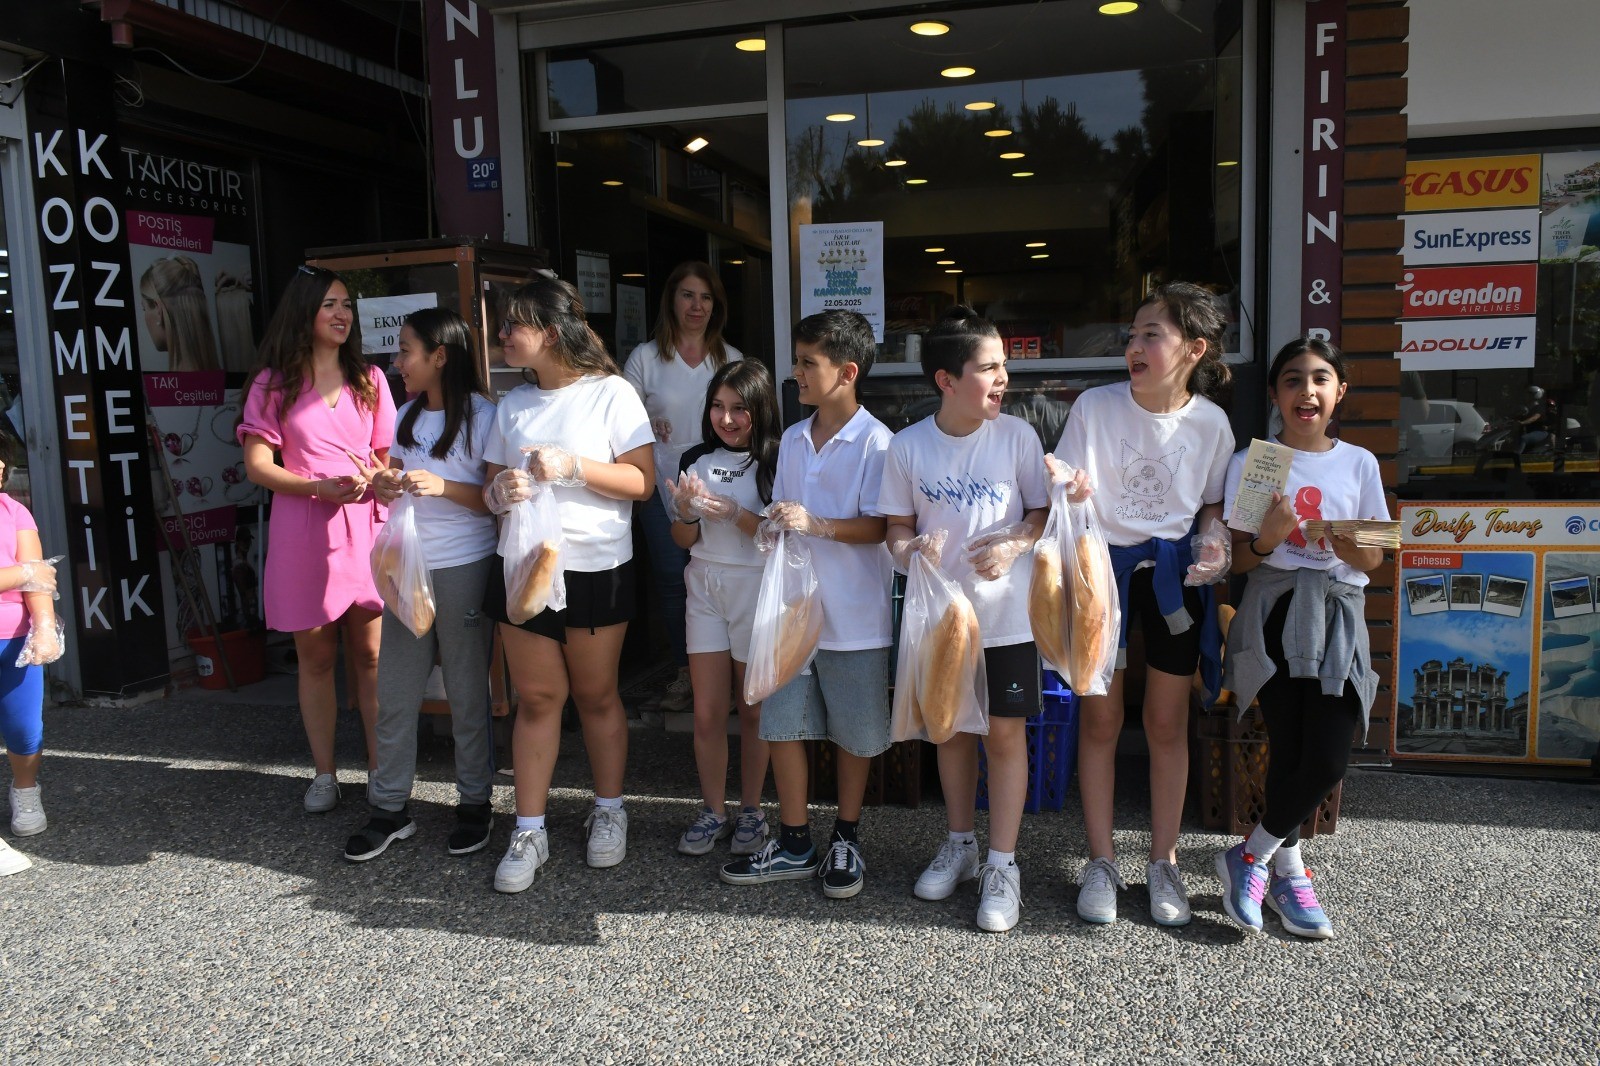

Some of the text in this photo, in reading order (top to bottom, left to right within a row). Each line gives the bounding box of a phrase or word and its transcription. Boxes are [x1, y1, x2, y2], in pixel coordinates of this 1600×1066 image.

[1307, 22, 1338, 244] FIRIN
[1400, 167, 1532, 196] EGASUS
[125, 186, 248, 216] ACCESSORIES
[138, 214, 182, 236] POSTİŞ
[151, 232, 202, 250] Modelleri
[1413, 228, 1531, 251] SunExpress
[824, 299, 862, 307] 22.05.2025
[1409, 282, 1522, 307] corendon
[1460, 303, 1521, 313] AIRLINES
[374, 315, 408, 329] EKM
[381, 335, 394, 347] 10
[1401, 336, 1528, 353] ADOLUJET
[35, 129, 112, 630] KOZMETİK
[78, 128, 154, 622] KOZMETİK
[151, 376, 179, 390] TAKI
[174, 390, 218, 405] Çeşitleri
[1411, 507, 1543, 543] Daily Tours
[190, 528, 228, 542] Dövme
[1411, 554, 1451, 566] Ephesus
